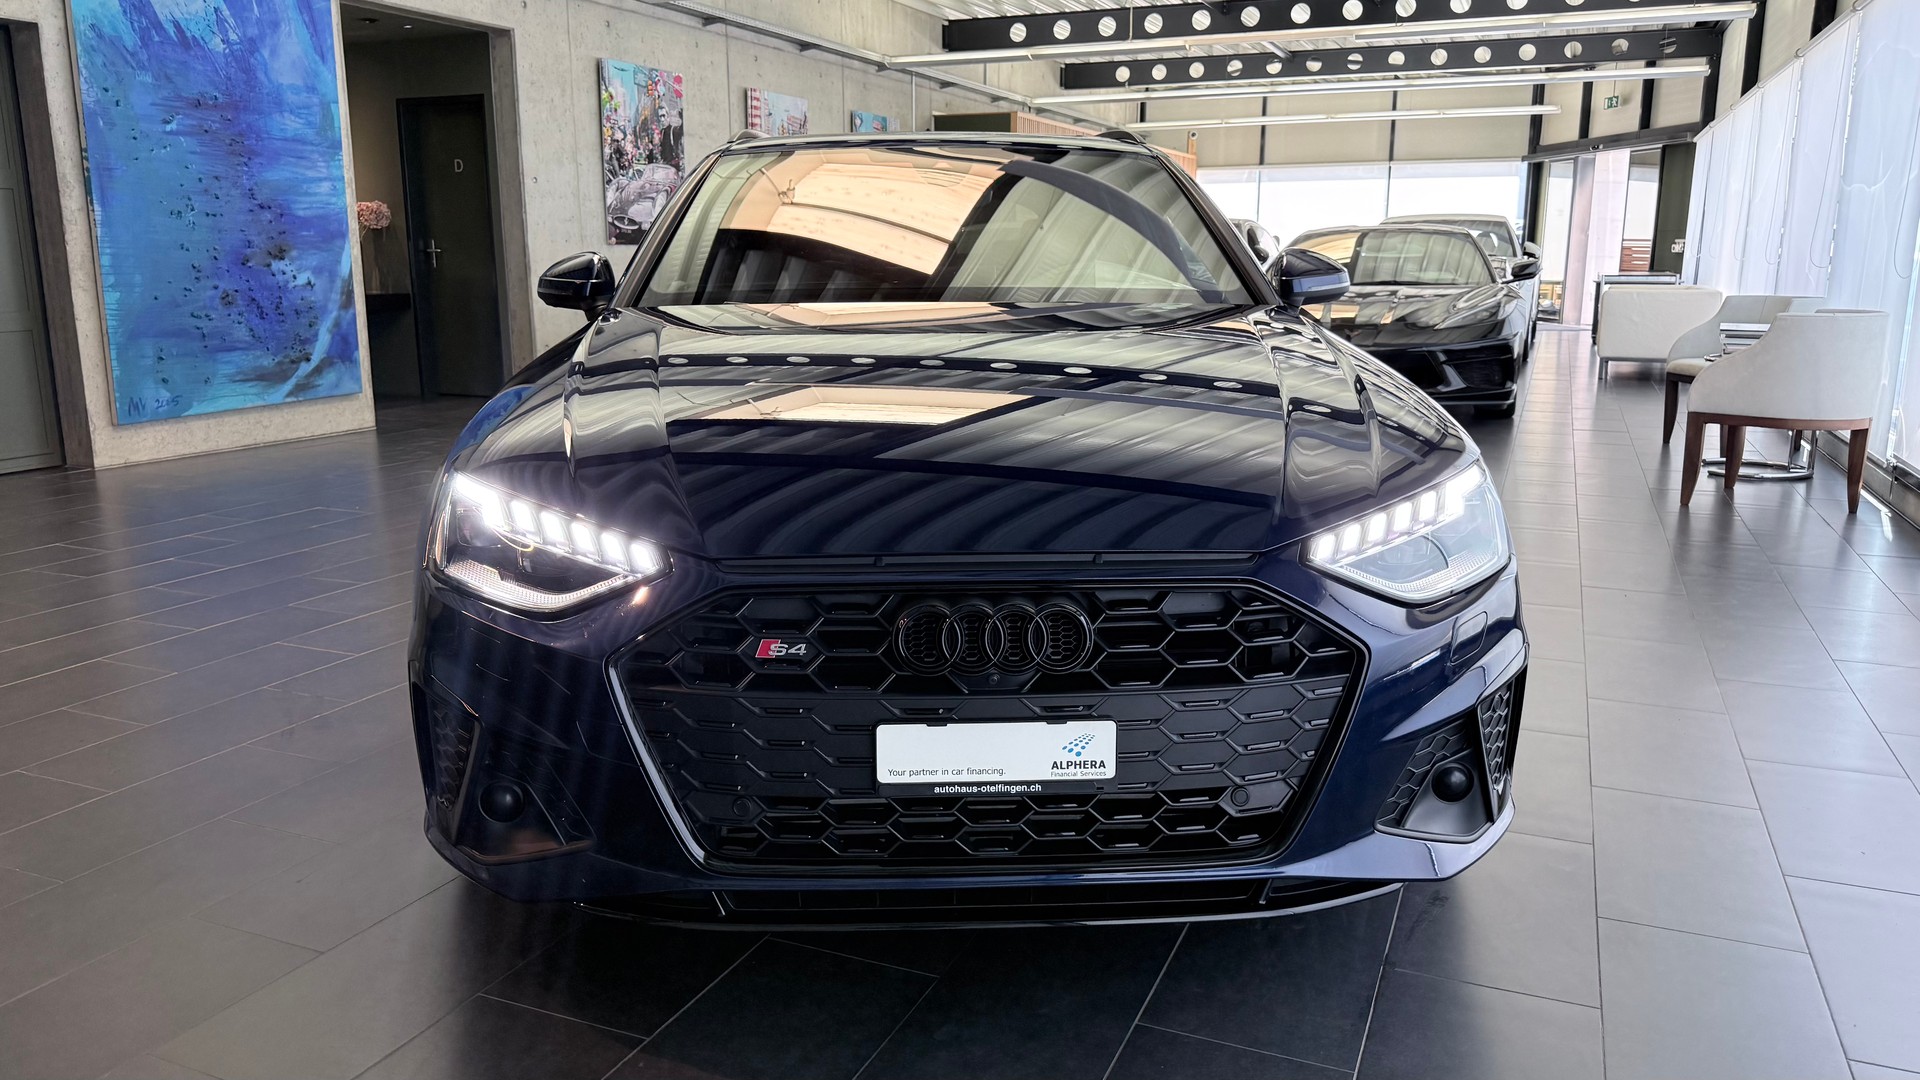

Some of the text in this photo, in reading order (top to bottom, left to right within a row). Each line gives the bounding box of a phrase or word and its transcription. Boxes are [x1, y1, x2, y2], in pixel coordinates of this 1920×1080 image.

[454, 158, 464, 173] D
[768, 643, 807, 656] S4
[1051, 760, 1106, 770] ALPHERA
[887, 766, 1007, 778] Your partner in car financing.
[1050, 770, 1079, 778] Financial
[933, 783, 1042, 794] autohaus-otelfingen.ch
